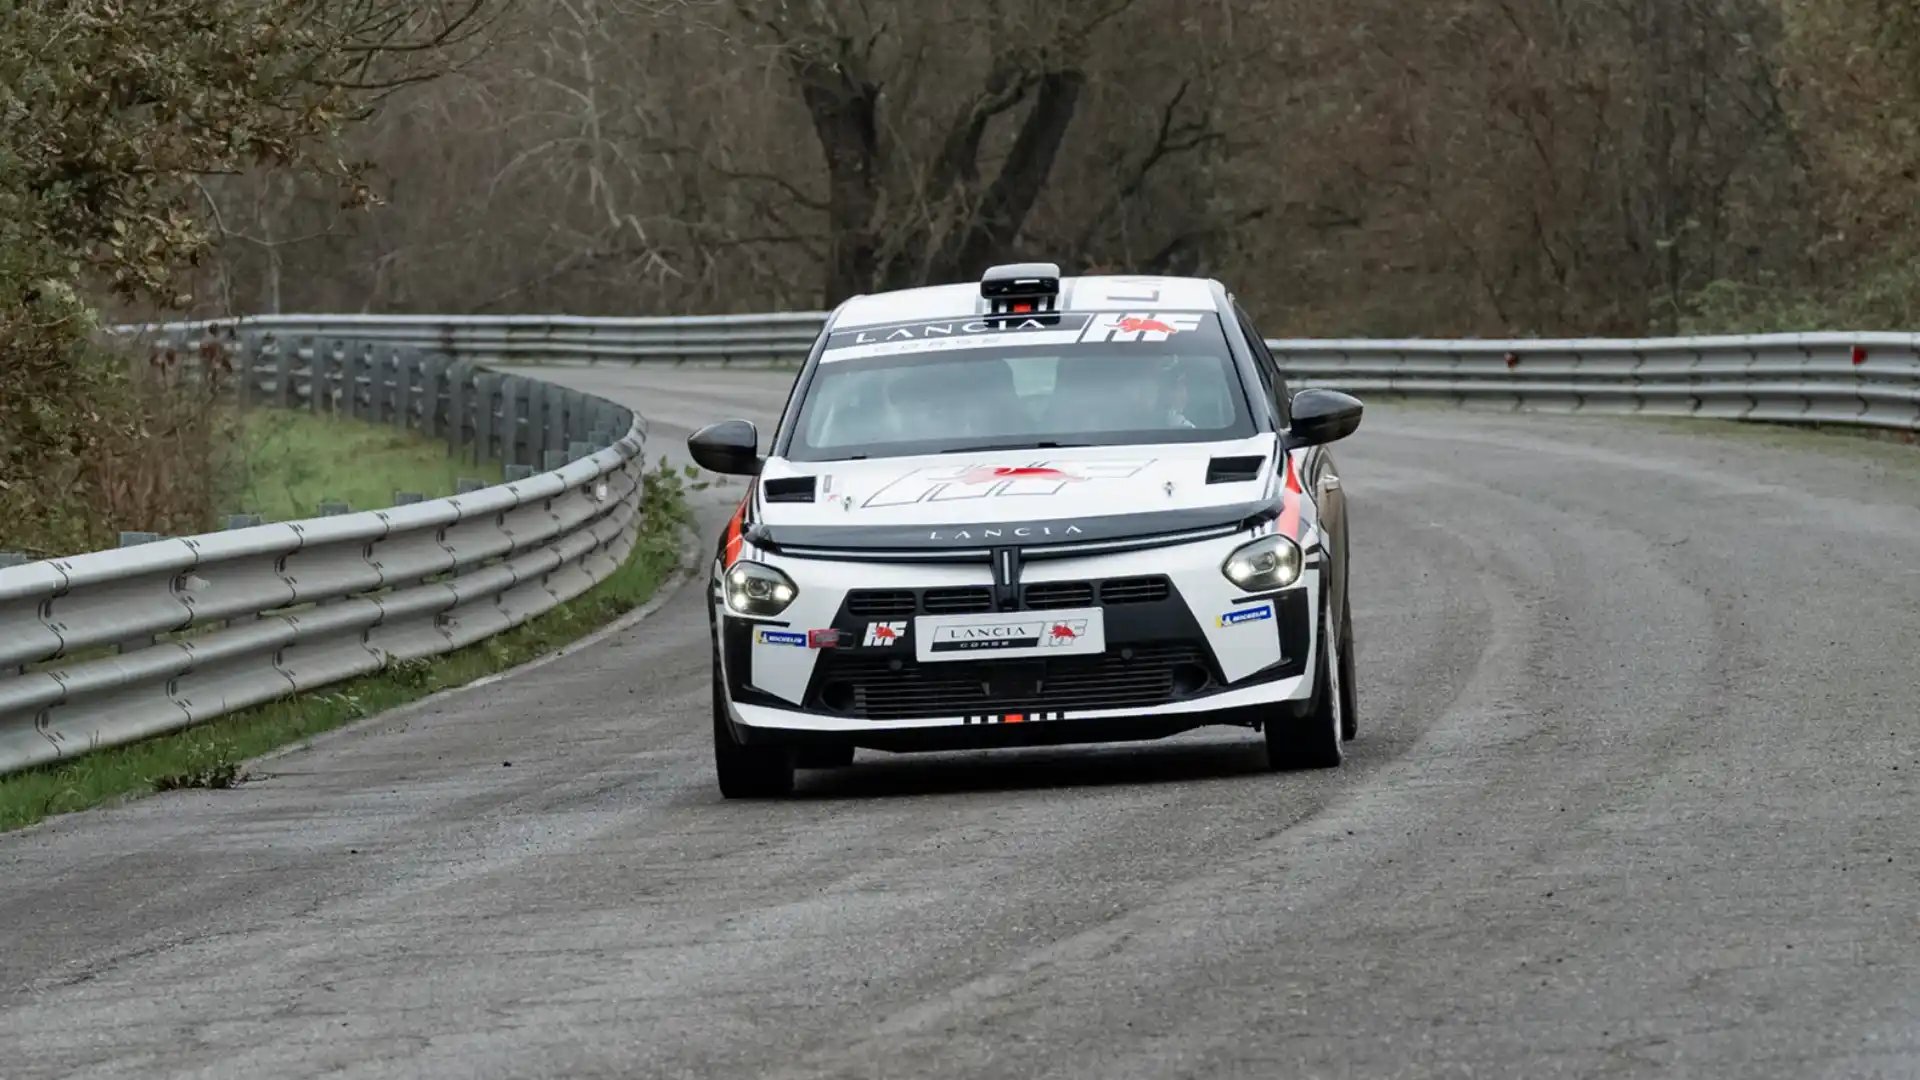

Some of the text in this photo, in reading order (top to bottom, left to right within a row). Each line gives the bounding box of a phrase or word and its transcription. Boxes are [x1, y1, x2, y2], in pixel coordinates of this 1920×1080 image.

[855, 319, 1045, 343] LANCIA
[929, 524, 1083, 540] LANCIA
[951, 626, 1026, 639] LANCIA
[959, 640, 1010, 648] CORSE
